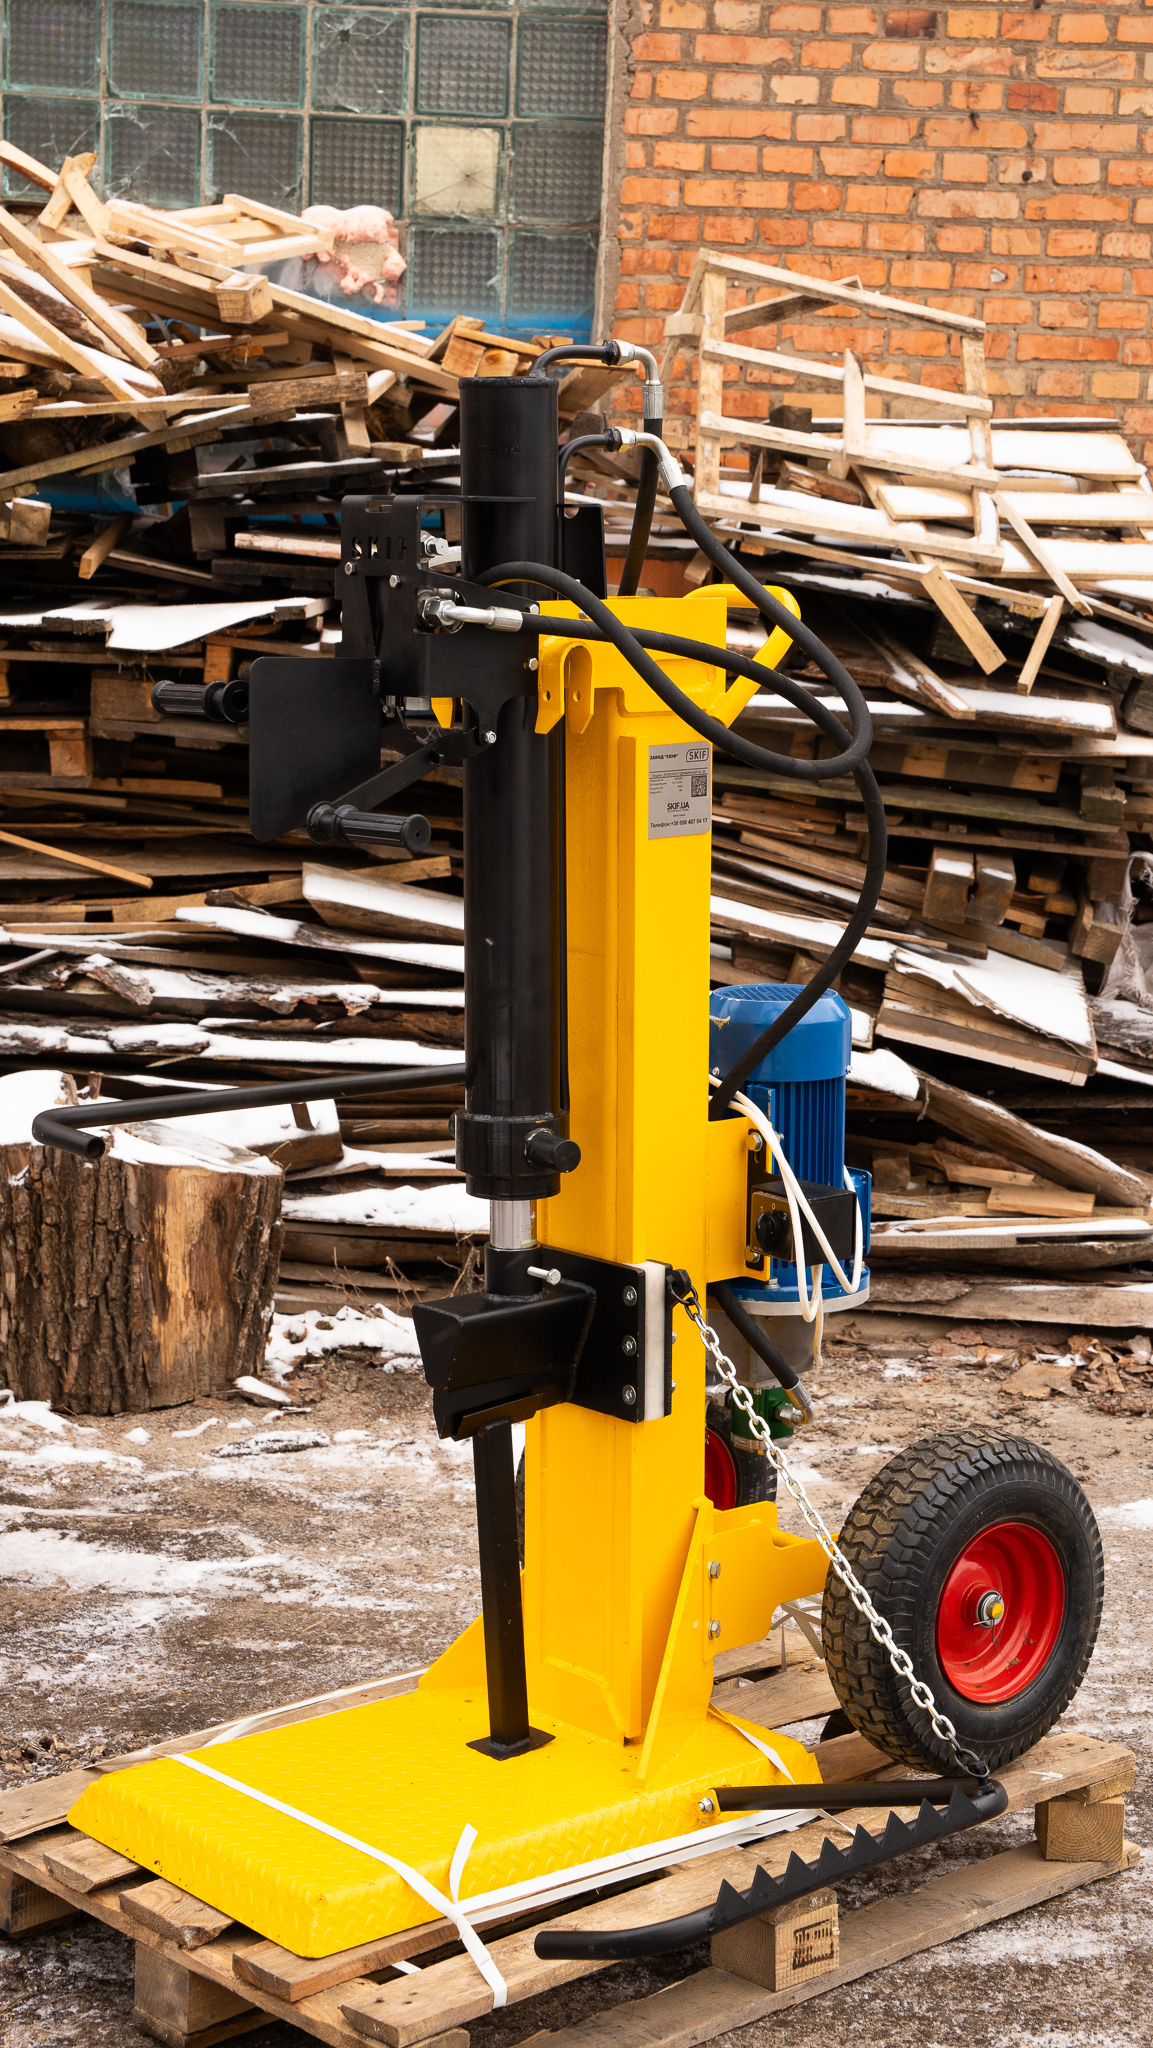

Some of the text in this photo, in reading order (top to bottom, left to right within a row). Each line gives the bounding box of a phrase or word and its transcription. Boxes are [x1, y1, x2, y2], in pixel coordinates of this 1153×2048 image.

[351, 536, 408, 559] SKIF
[689, 750, 707, 760] SKIF
[667, 801, 690, 810] SKIF.UA
[772, 1202, 776, 1210] 0
[782, 1212, 788, 1221] 2
